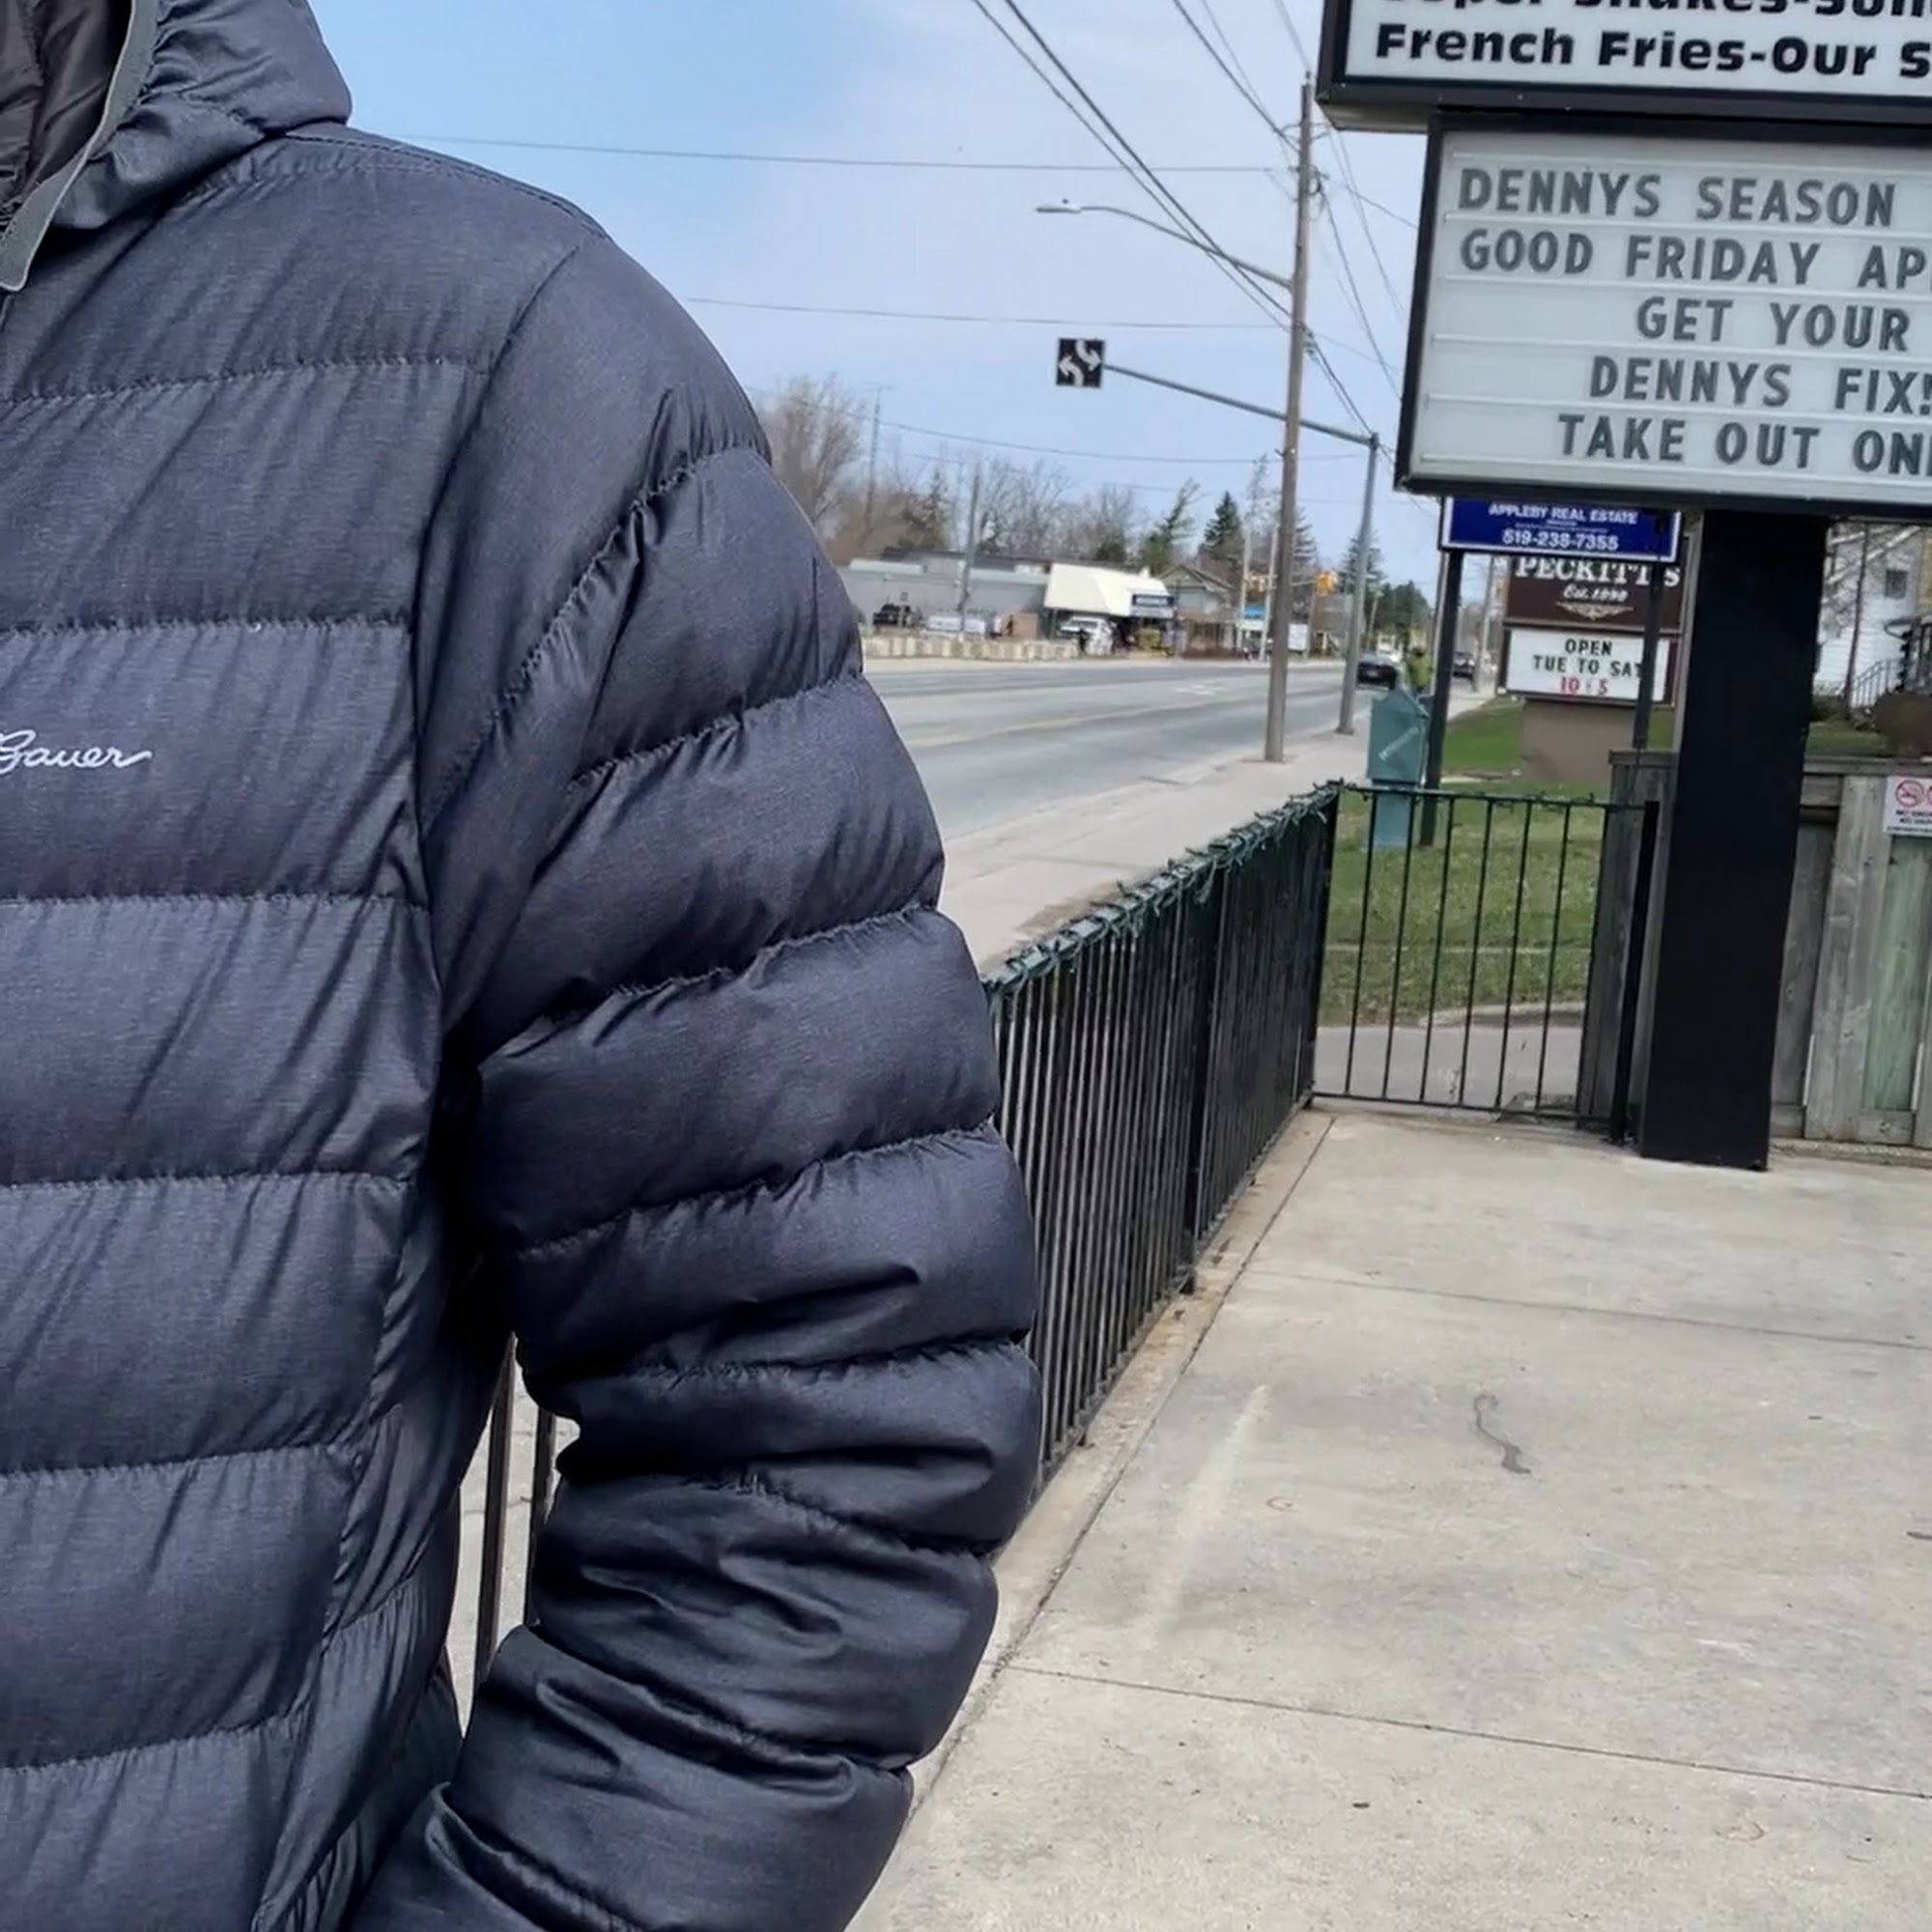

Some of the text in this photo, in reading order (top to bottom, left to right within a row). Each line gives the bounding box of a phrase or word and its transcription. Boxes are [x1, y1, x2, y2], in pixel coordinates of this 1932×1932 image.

[1377, 23, 1576, 65] French
[1598, 31, 1877, 76] Fries-Our
[1457, 168, 1896, 228] DENNYS SEASON
[1459, 229, 1932, 290] GOOD FRIDAY AP
[1636, 296, 1911, 353] GET YOUR
[1589, 355, 1792, 409] DENNYS
[1558, 413, 1932, 477] TAKE OUT ON
[1488, 503, 1548, 519] APPLEBY
[1551, 507, 1587, 523] REAL
[1590, 509, 1639, 525] ESTATE
[1515, 556, 1681, 587] PECKITTS
[1533, 655, 1566, 673] TUE
[1578, 658, 1600, 675] TO
[1565, 638, 1612, 656] OPEN
[1561, 676, 1580, 694] 10
[1599, 679, 1607, 696] 5
